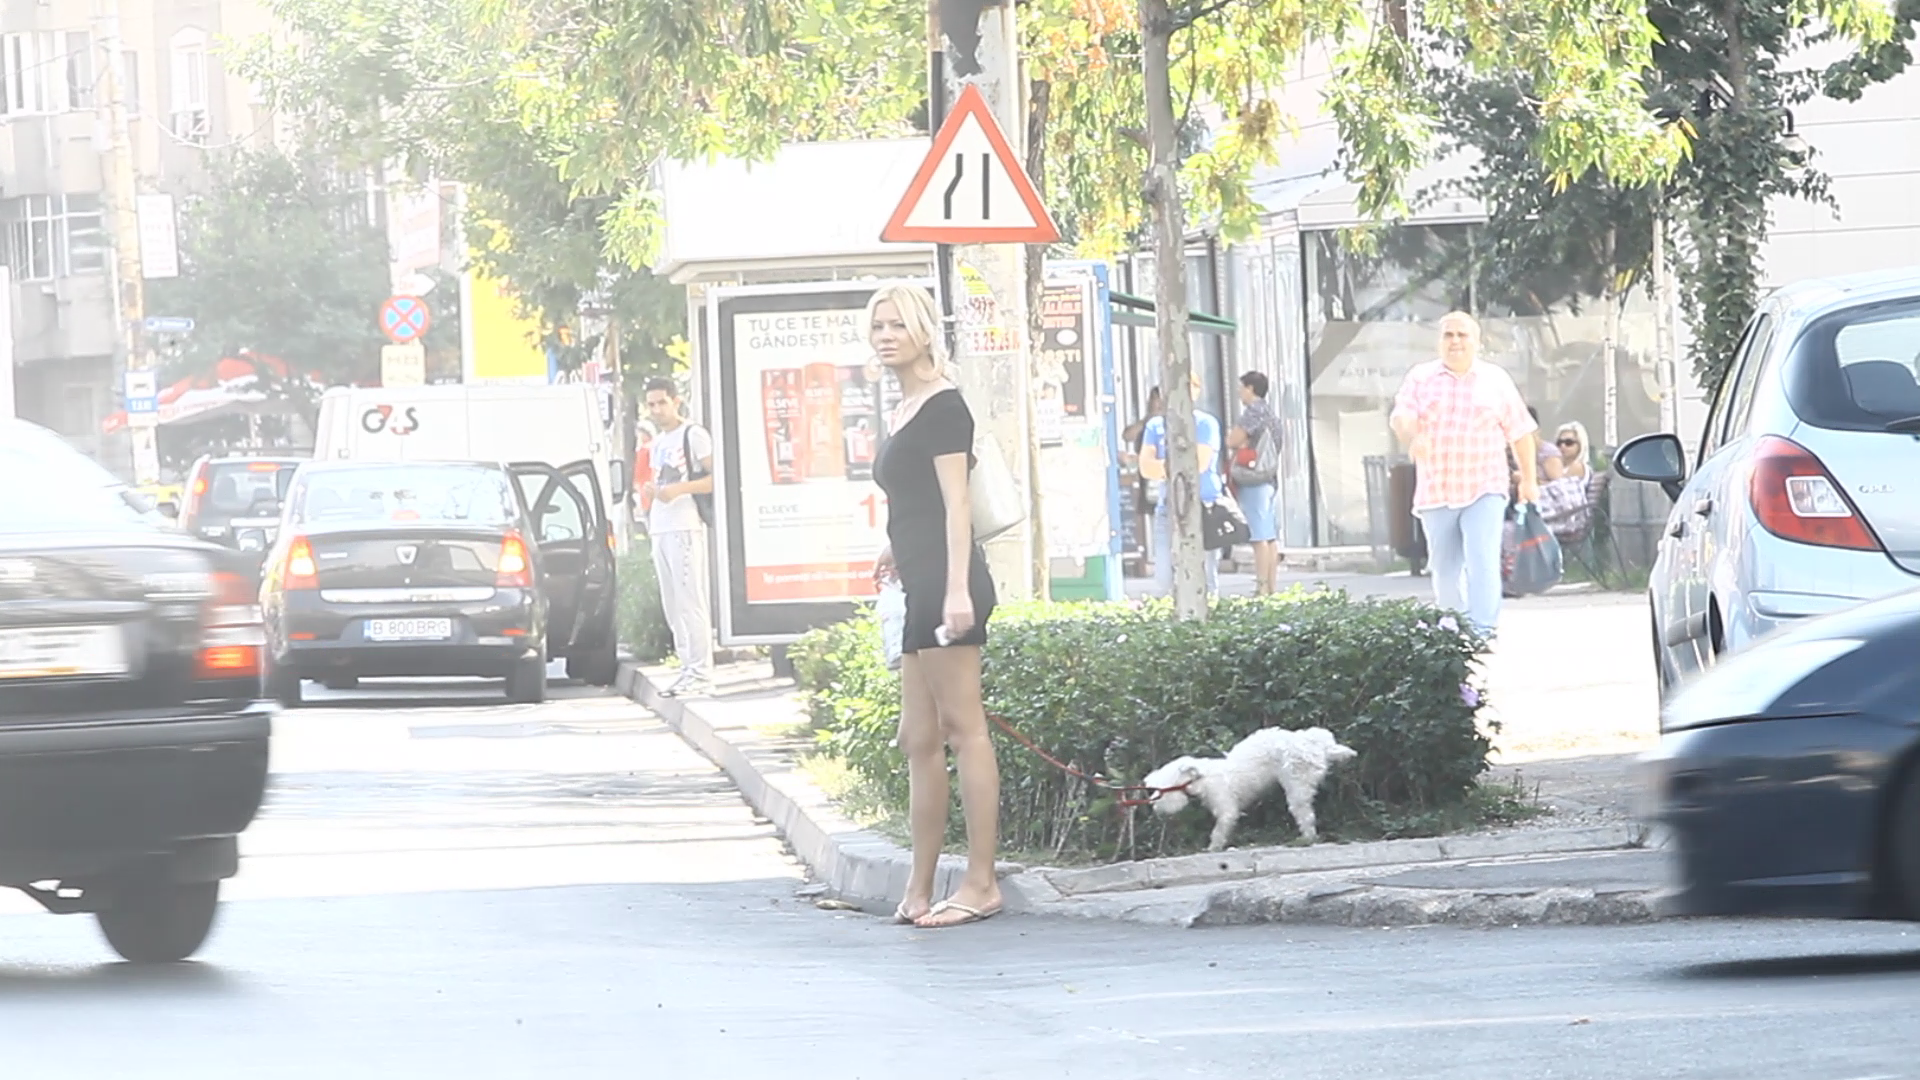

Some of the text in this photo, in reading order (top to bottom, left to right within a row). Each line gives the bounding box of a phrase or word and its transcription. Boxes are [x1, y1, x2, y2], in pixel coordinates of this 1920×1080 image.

[748, 314, 858, 332] TU CE TE MAI
[749, 331, 834, 350] GÂNDEȘTI
[361, 404, 419, 436] G4S
[758, 504, 800, 515] ELSEVE
[373, 620, 448, 634] B 800 BRG
